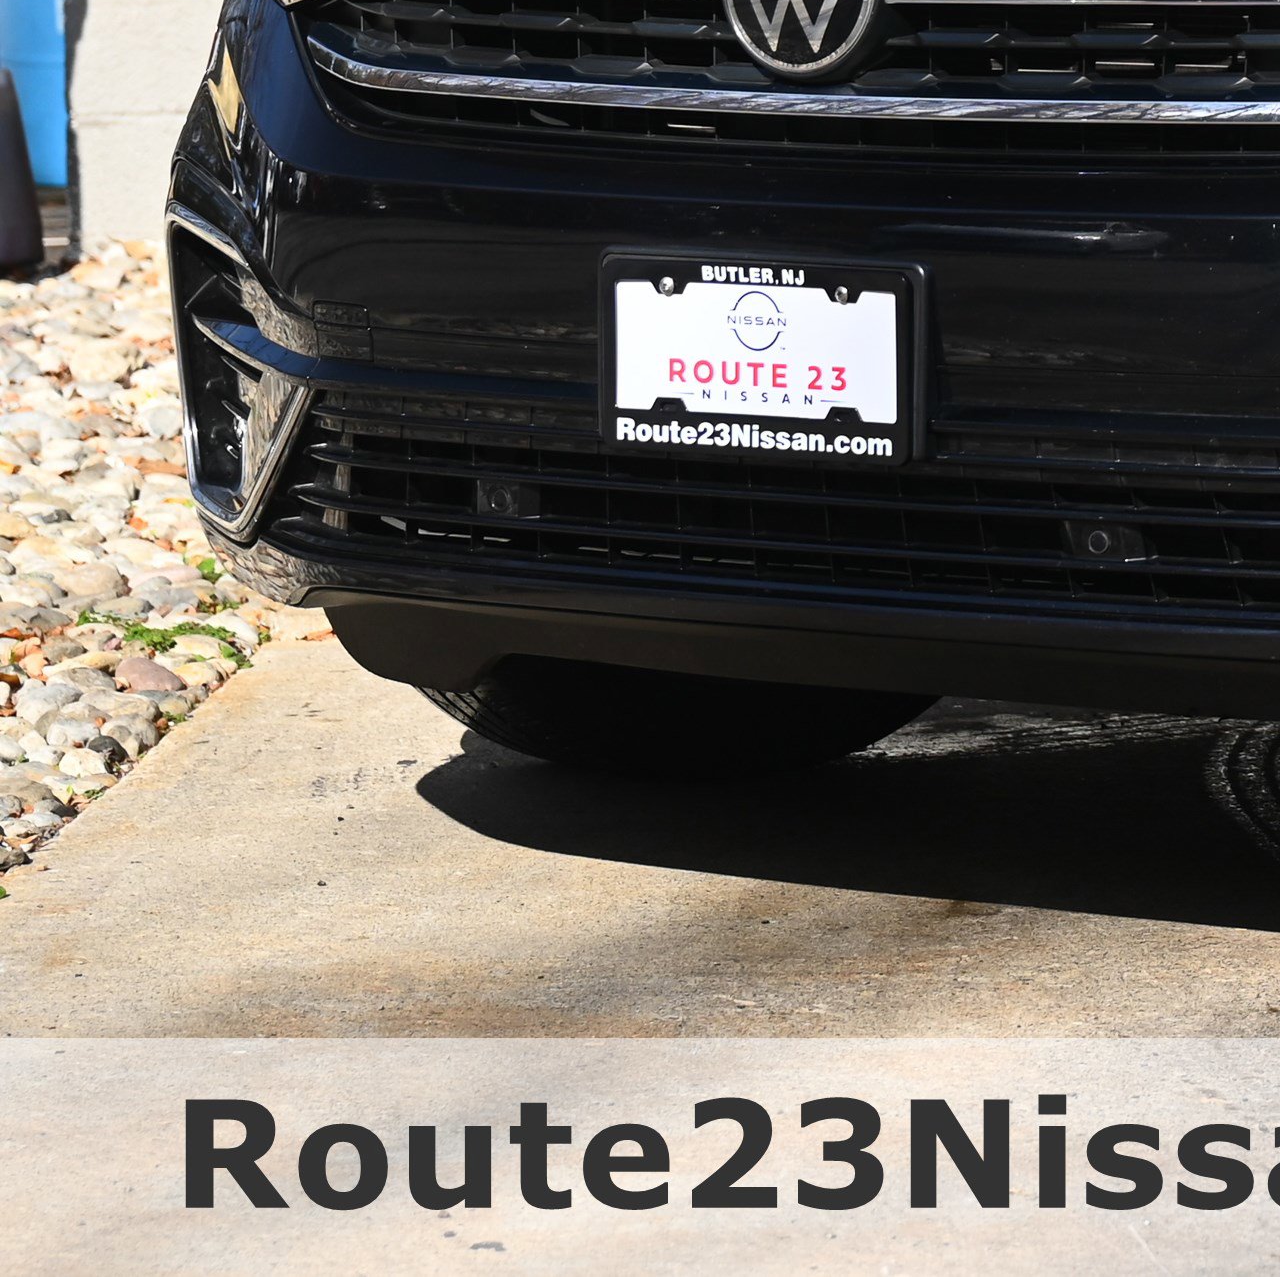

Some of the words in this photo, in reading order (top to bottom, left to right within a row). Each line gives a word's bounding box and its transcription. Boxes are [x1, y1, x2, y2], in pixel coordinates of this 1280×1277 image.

[727, 315, 787, 327] NISSAN
[669, 358, 788, 388] ROUTE
[807, 366, 847, 391] 23
[702, 389, 814, 405] NISSAN
[616, 417, 893, 457] Route23Nissan.com
